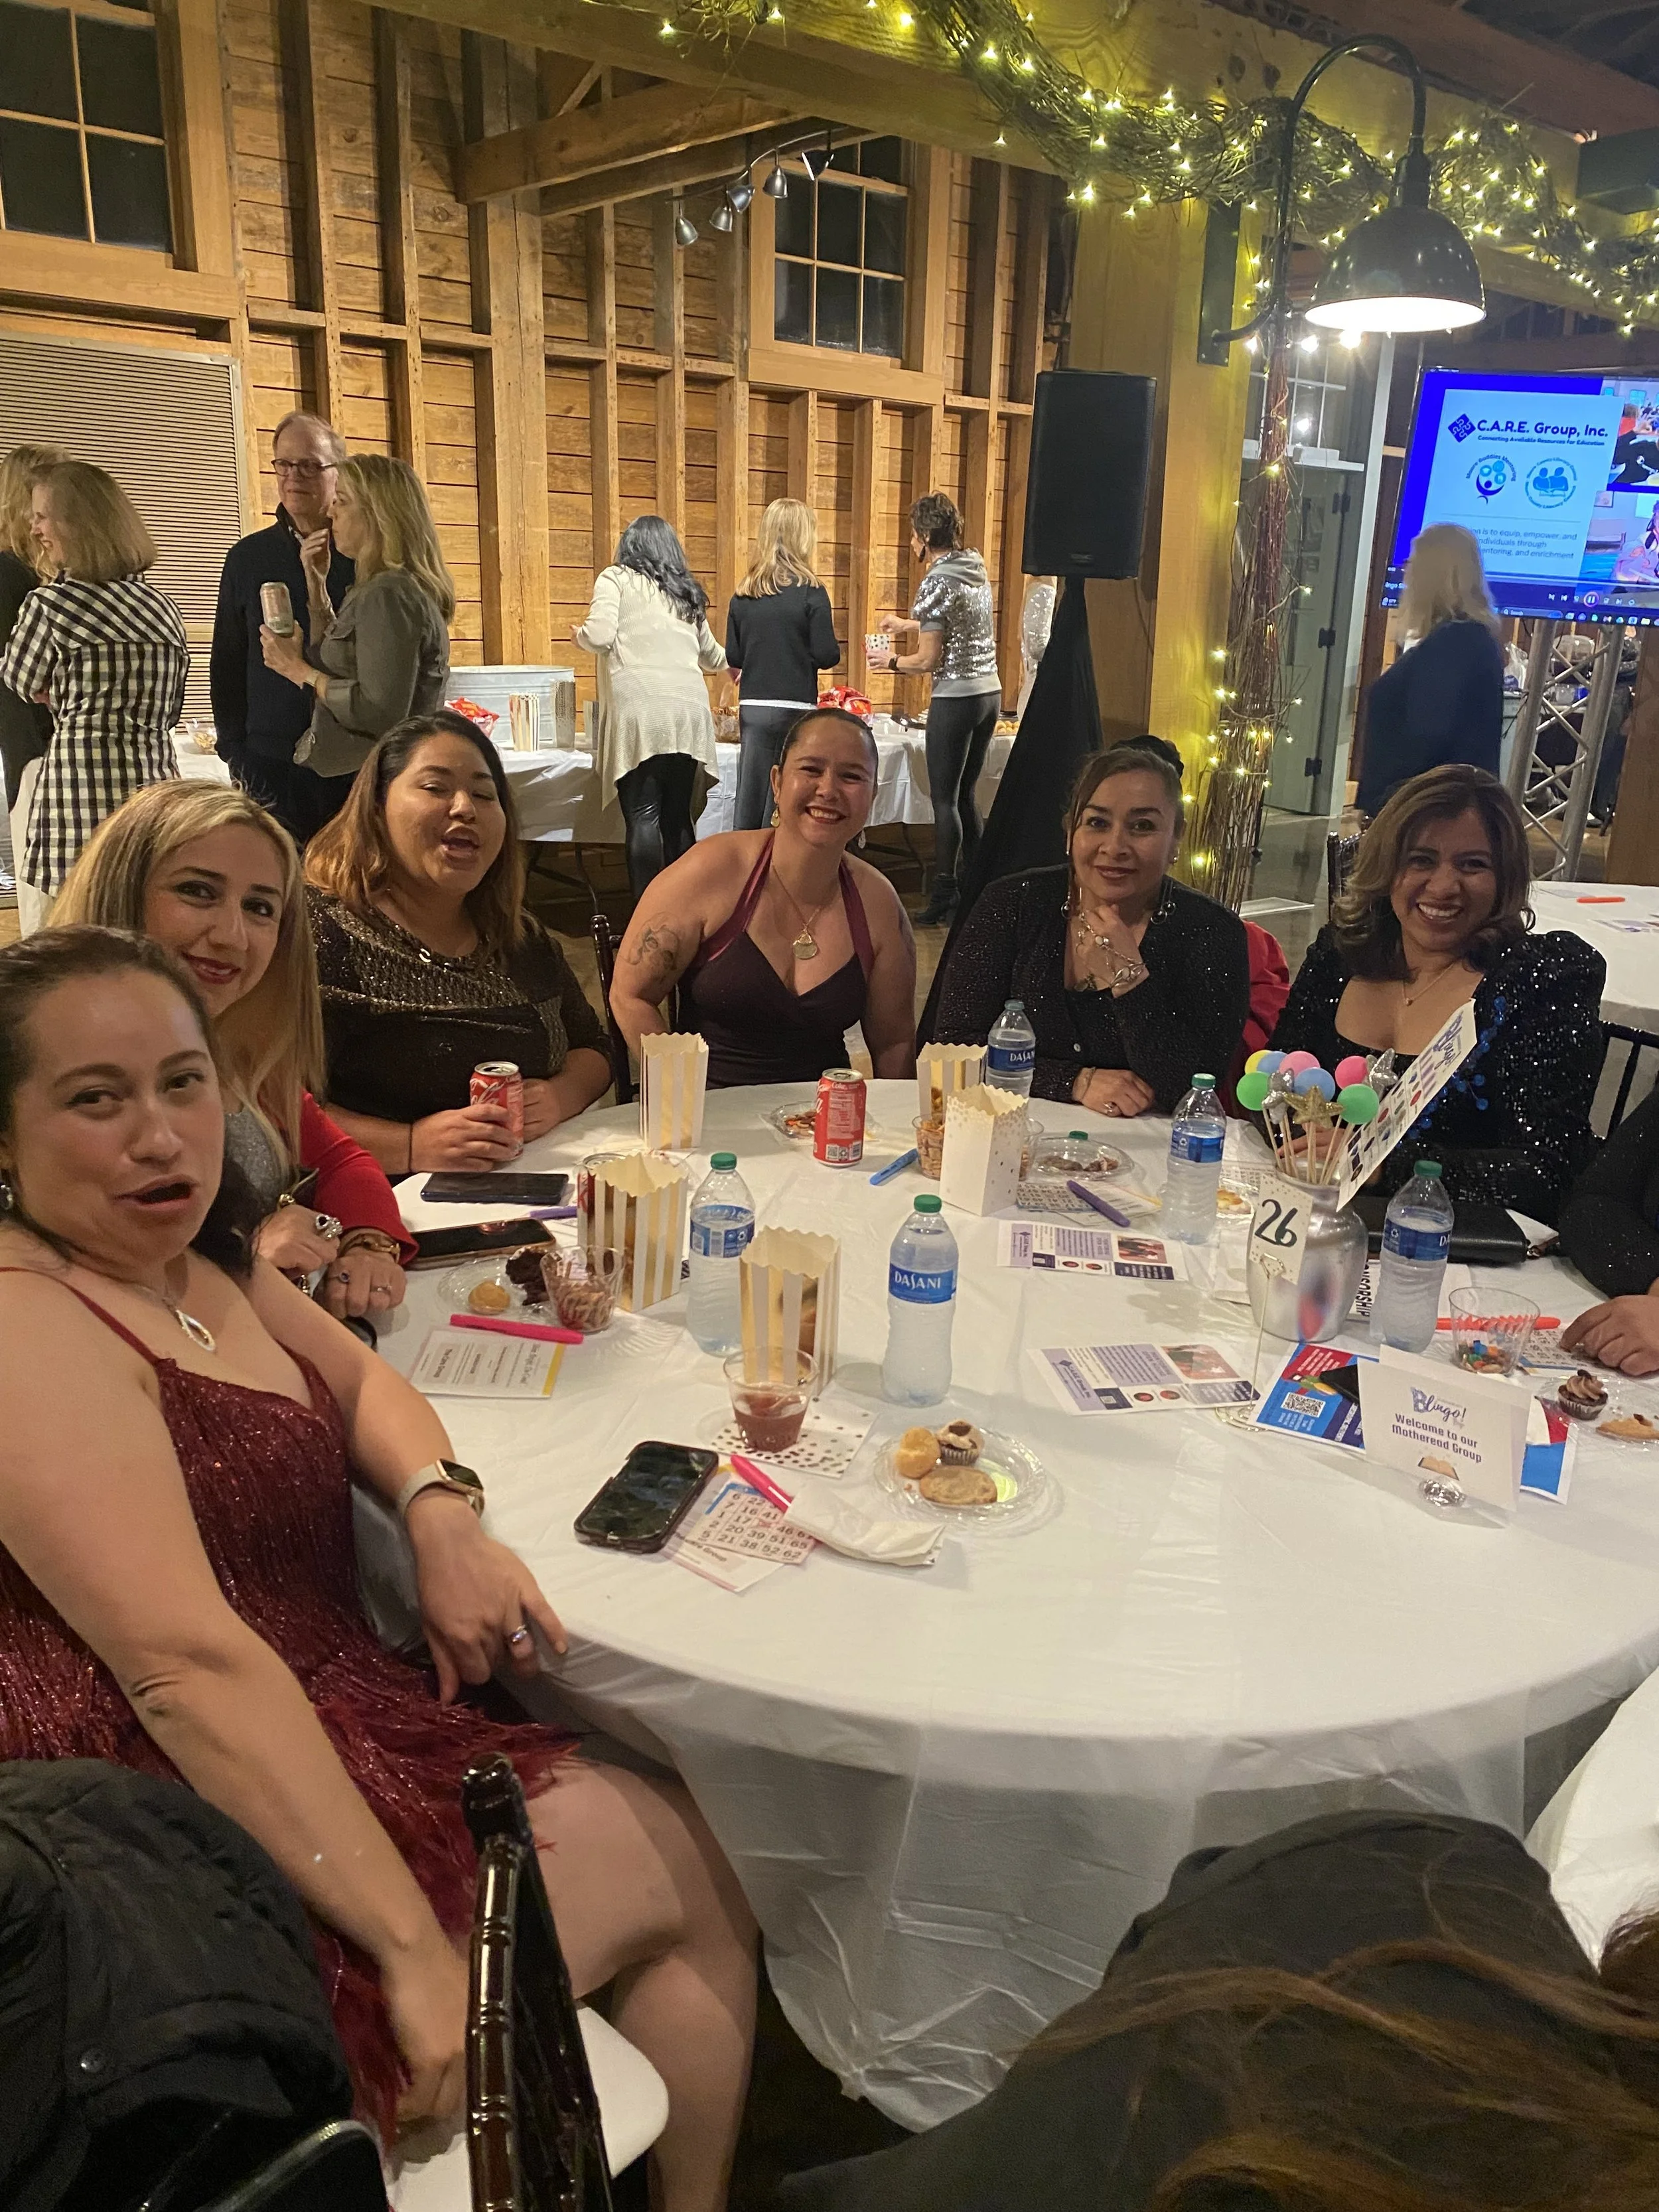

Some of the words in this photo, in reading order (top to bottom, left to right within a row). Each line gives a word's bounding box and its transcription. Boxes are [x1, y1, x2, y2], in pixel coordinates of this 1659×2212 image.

[1477, 419, 1529, 433] C.A.R.E.
[1534, 422, 1580, 439] Group,
[1584, 425, 1608, 437] Inc.
[1479, 537, 1515, 546] ndividuals
[1518, 540, 1547, 549] through
[1010, 1051, 1035, 1062] DASAN
[1254, 1199, 1298, 1248] 26
[895, 1271, 941, 1290] DASANI
[1396, 1414, 1444, 1436] Welcome
[1447, 1430, 1457, 1441] to
[1461, 1436, 1477, 1448] our
[1392, 1424, 1449, 1450] Motheread
[1453, 1443, 1482, 1463] Group
[748, 1497, 765, 1506] 22
[741, 1507, 757, 1515] 16
[762, 1511, 778, 1520] 41
[725, 1524, 744, 1534] 20
[747, 1530, 766, 1540] 39
[769, 1535, 786, 1544] 51
[790, 1540, 808, 1550] 65
[733, 1516, 752, 1524] 17
[776, 1526, 794, 1535] 46
[798, 1531, 813, 1540] 6
[717, 1534, 735, 1544] 21
[740, 1540, 758, 1550] 38
[762, 1544, 780, 1554] 52
[783, 1550, 802, 1558] 62
